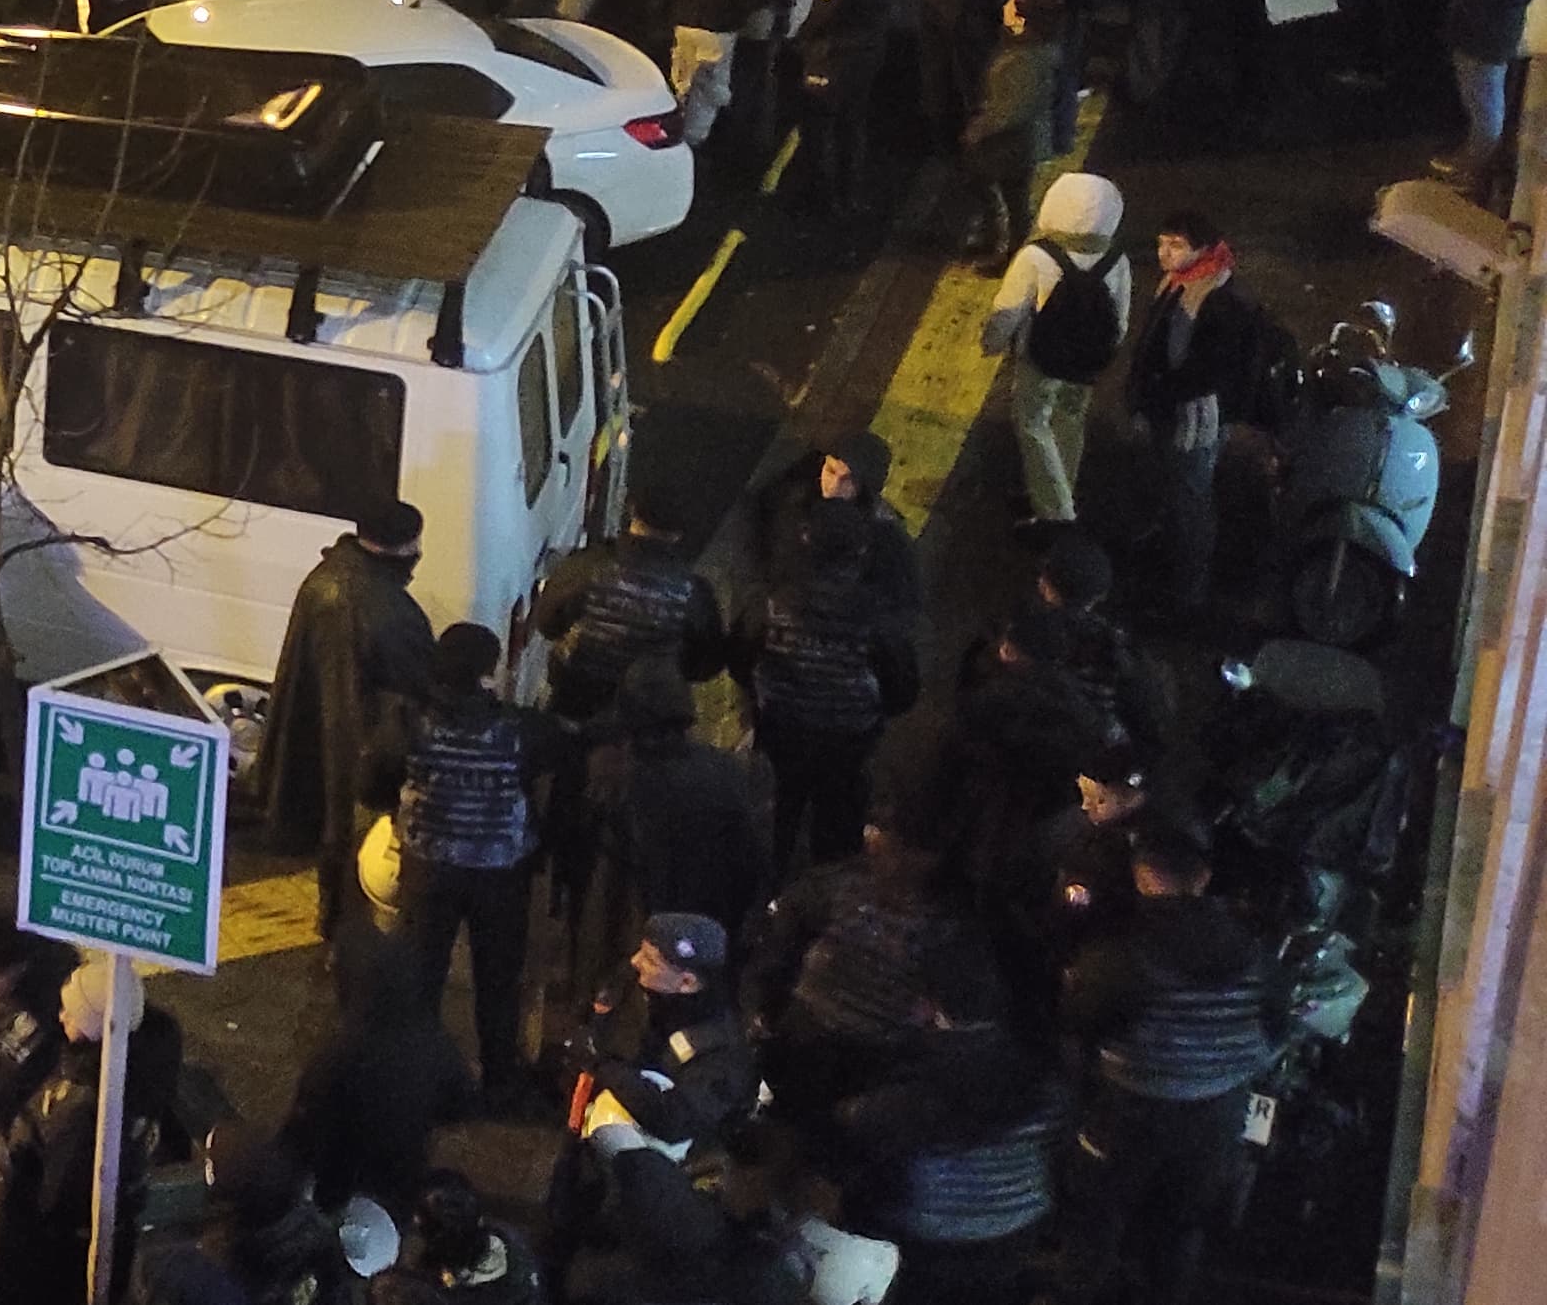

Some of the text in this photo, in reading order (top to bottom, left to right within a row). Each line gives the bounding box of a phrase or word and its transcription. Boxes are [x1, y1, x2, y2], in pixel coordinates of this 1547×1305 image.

[41, 854, 194, 904] TOPLANMA NOKTASI
[108, 851, 165, 878] DURUM
[50, 905, 173, 950] MUSTER POINT
[60, 888, 166, 929] EMERGENCY
